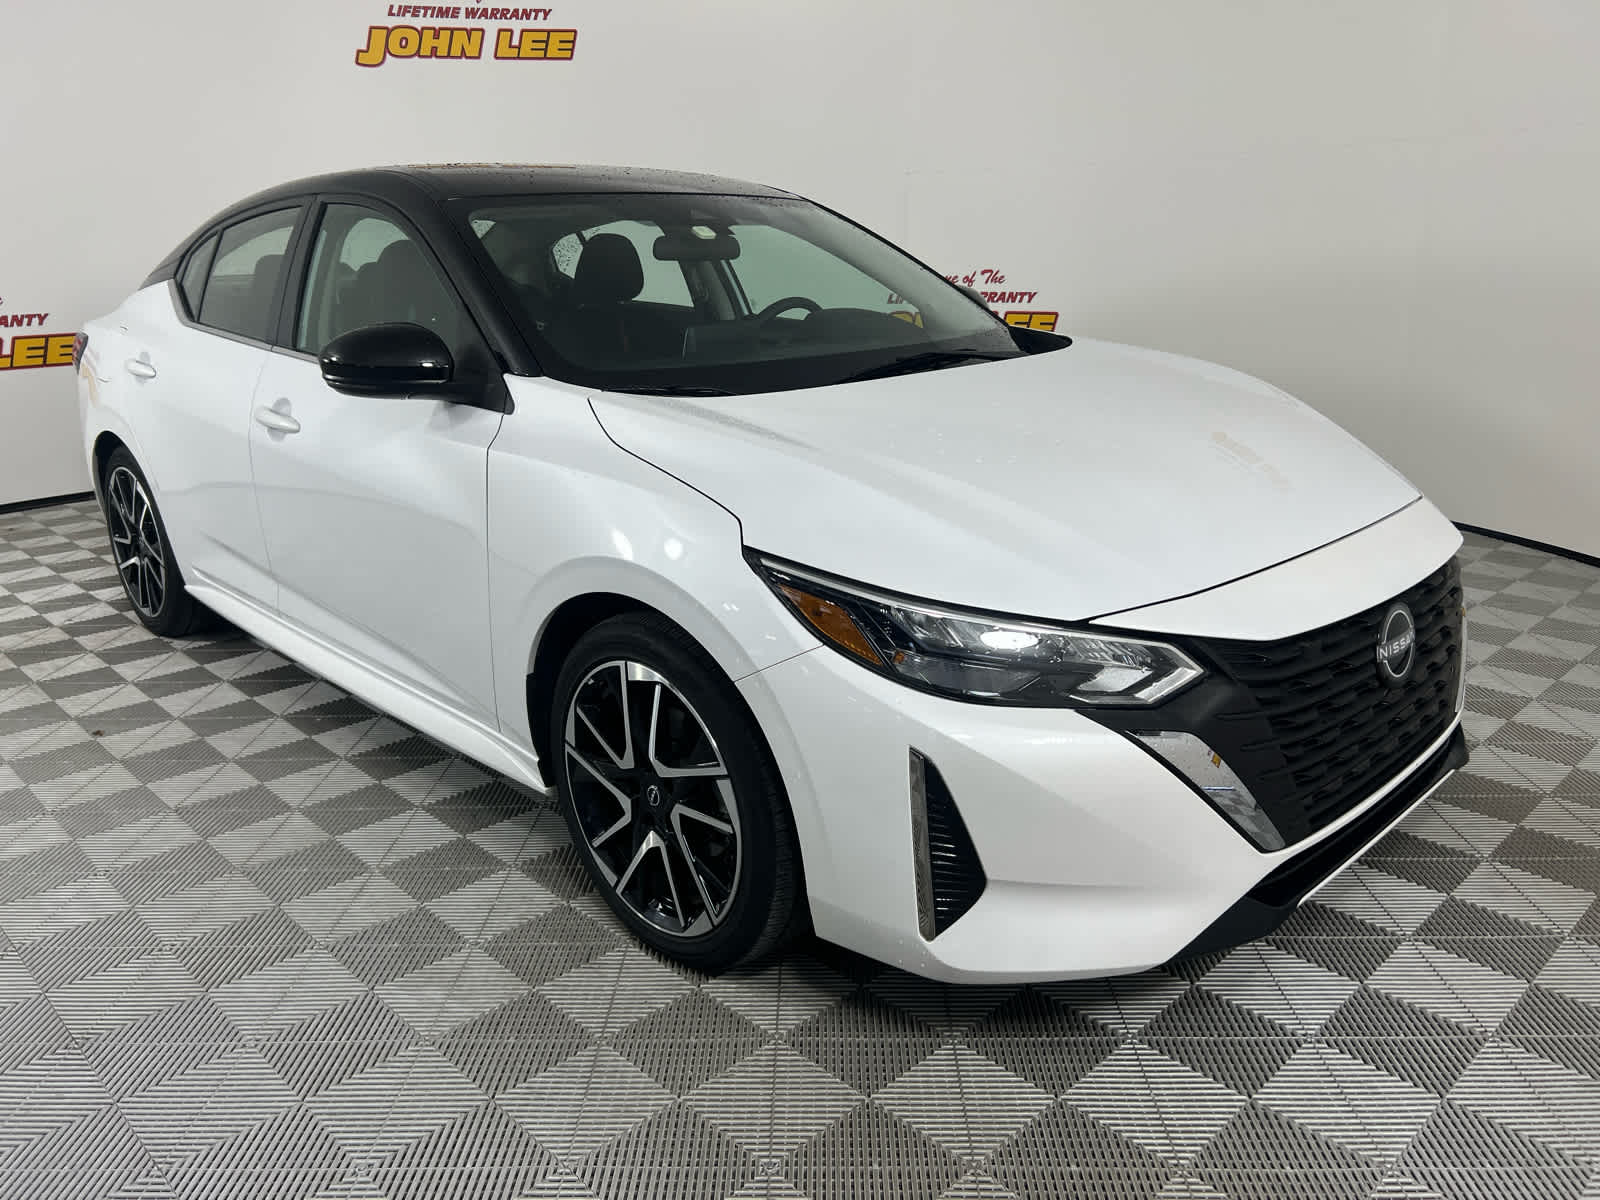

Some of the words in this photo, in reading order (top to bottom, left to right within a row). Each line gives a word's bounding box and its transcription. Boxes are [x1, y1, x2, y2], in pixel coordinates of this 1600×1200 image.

[387, 4, 461, 19] LIFETIME
[465, 7, 552, 20] WARRANTY
[355, 25, 485, 67] JOHN
[494, 28, 577, 60] LEE
[962, 270, 976, 287] of
[980, 269, 1006, 284] The
[993, 310, 1059, 332] EE
